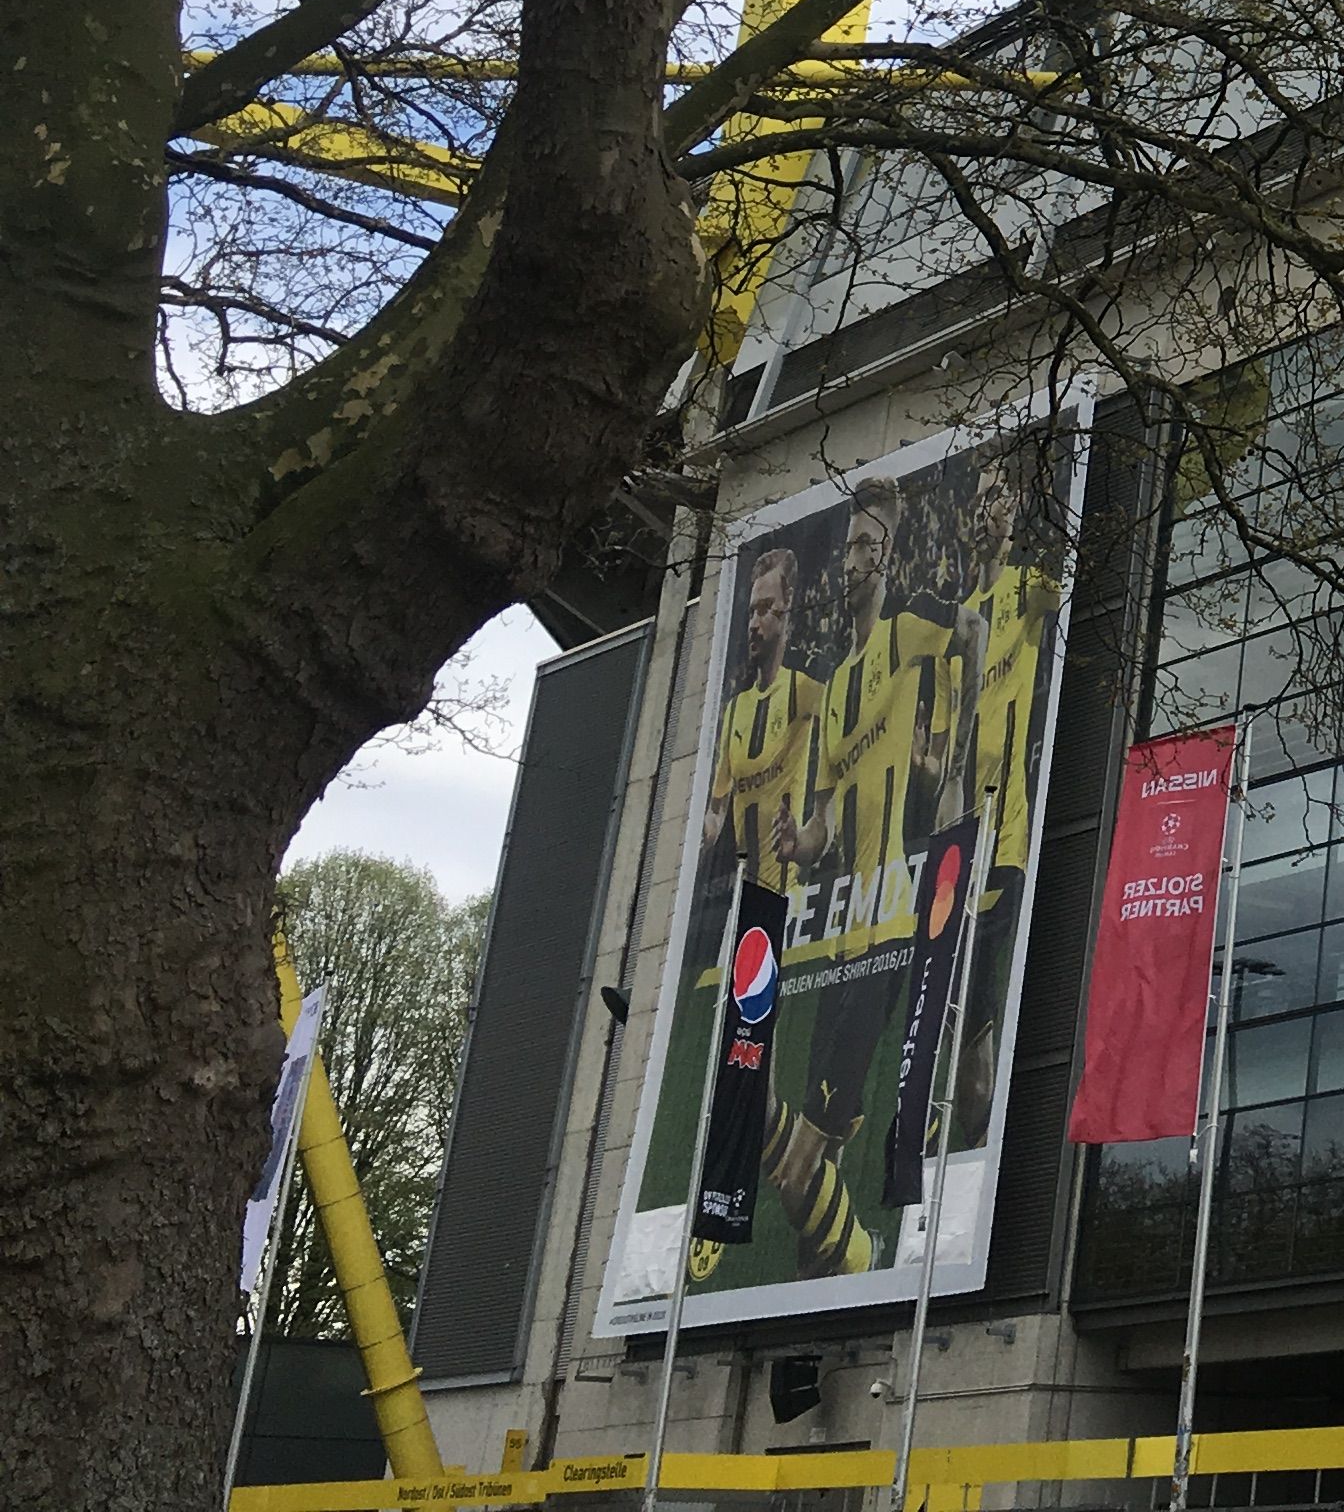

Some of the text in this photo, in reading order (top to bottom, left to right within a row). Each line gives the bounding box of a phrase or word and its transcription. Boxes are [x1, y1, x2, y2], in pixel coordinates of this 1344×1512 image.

[779, 946, 915, 997] NEUEN HOME SHIRT 2016/17
[563, 1462, 628, 1485] Clearingstelle
